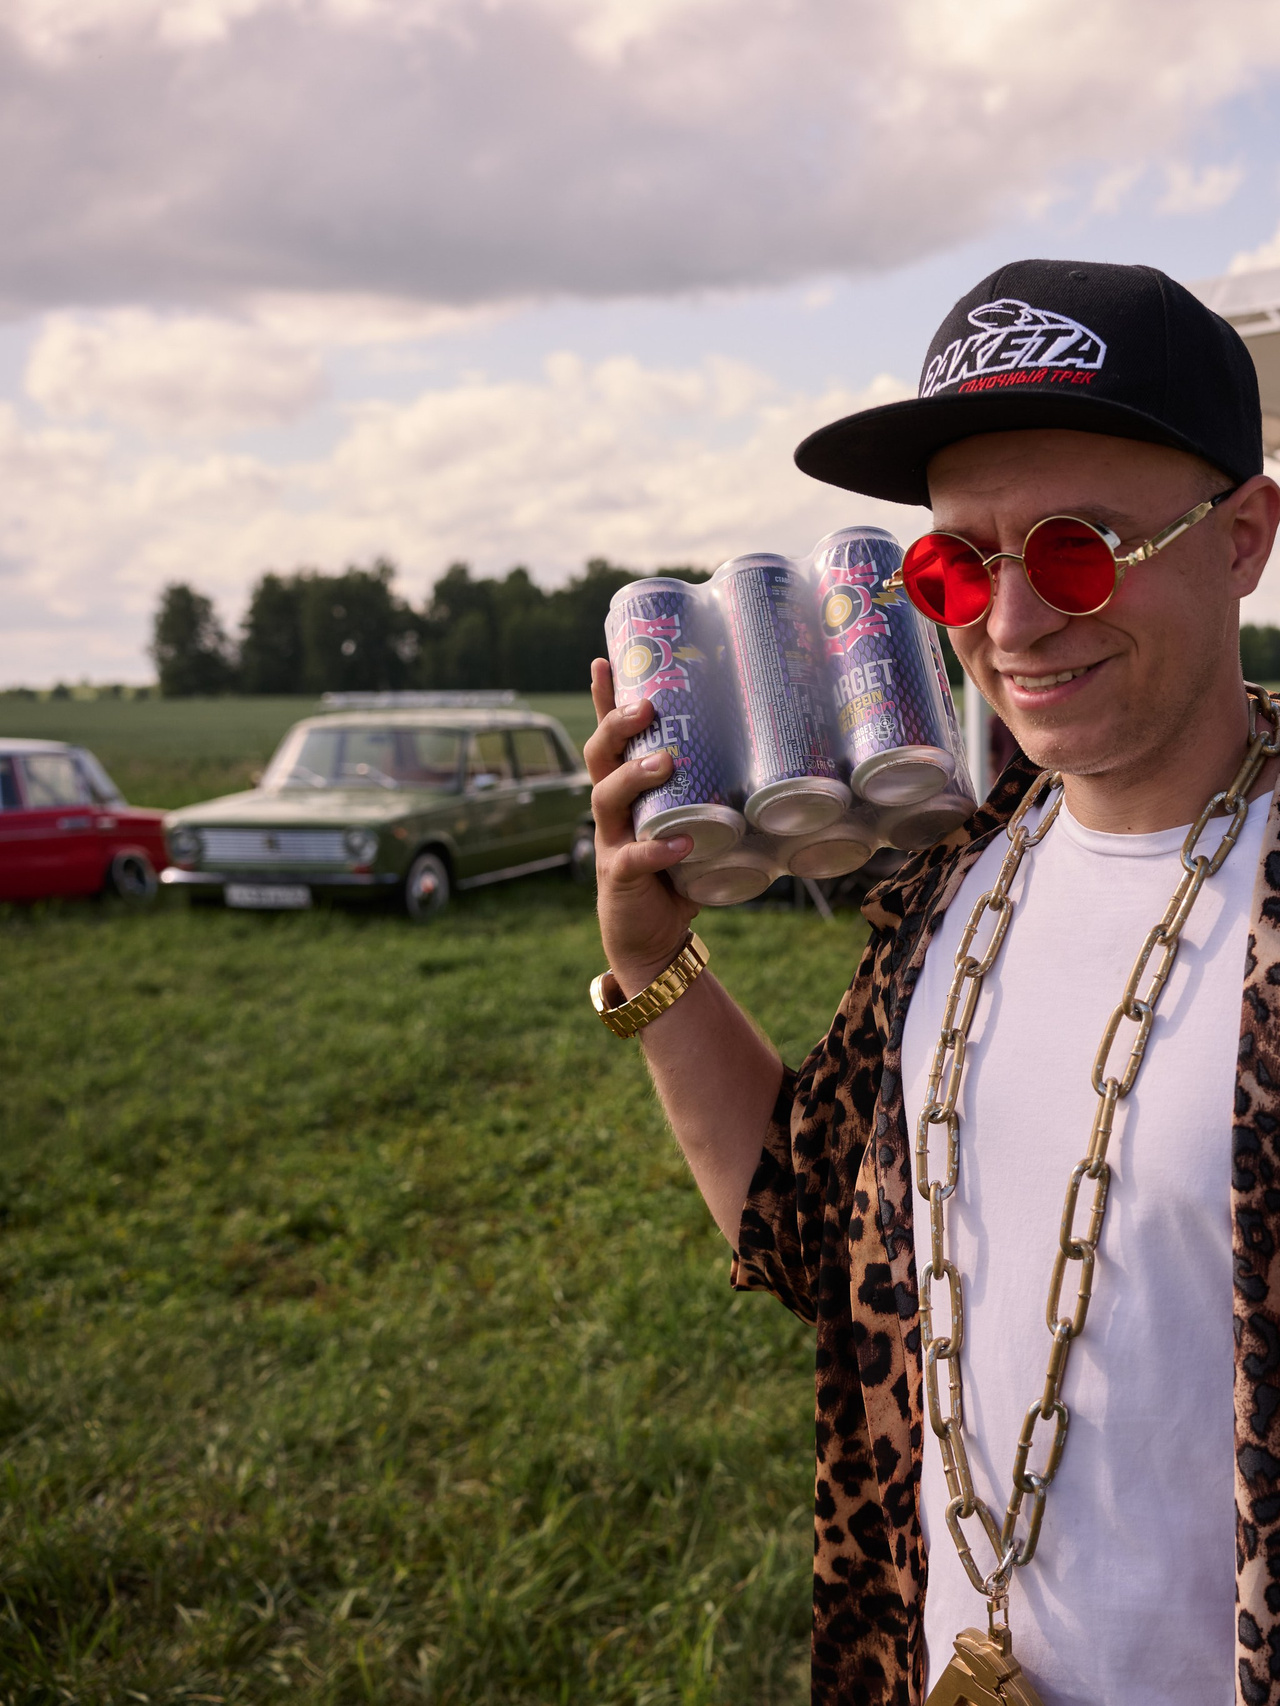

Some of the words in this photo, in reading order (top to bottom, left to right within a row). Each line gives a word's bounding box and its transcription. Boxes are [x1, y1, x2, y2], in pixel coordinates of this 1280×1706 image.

[1051, 369, 1098, 385] ТРЕК
[831, 658, 893, 710] ARGET
[864, 700, 897, 722] plum
